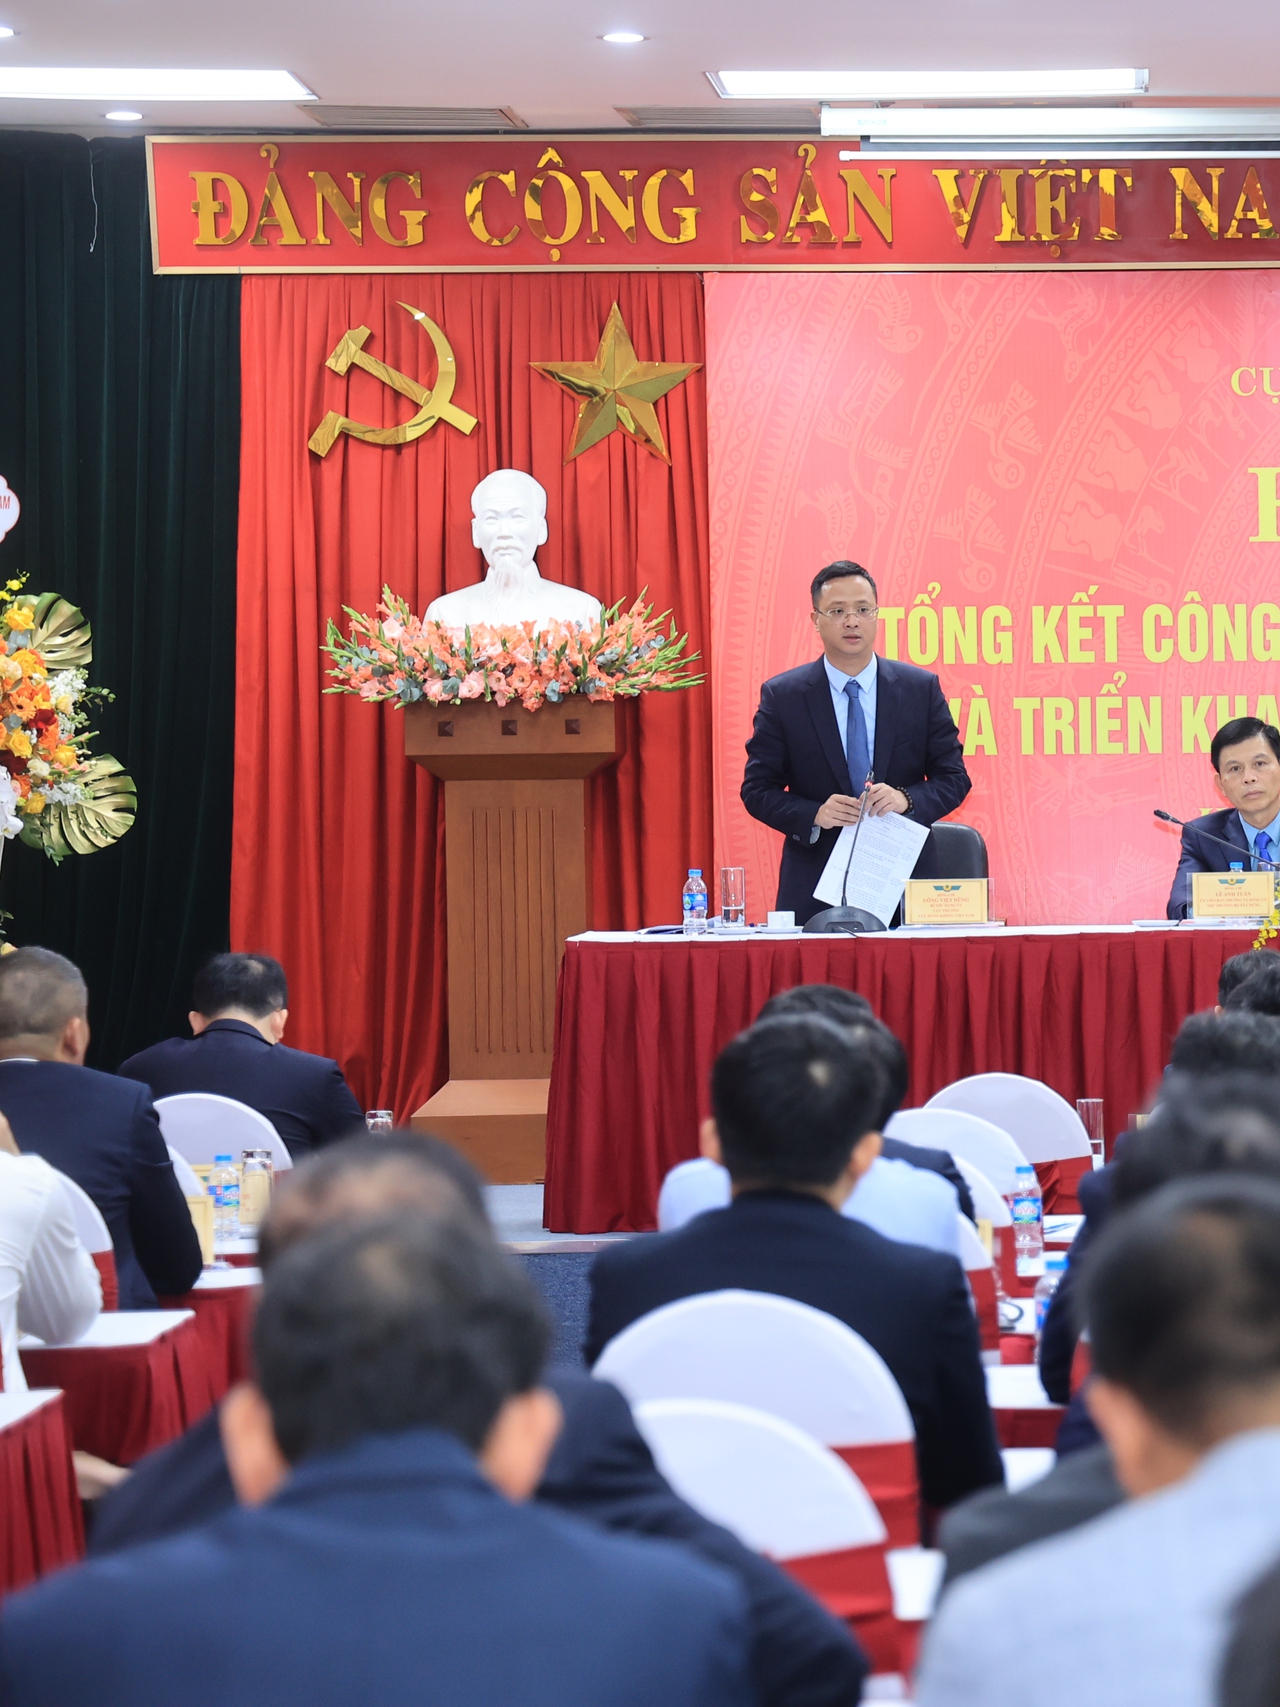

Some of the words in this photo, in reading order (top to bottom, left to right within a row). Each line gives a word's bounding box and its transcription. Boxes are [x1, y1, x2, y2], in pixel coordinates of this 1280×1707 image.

[189, 143, 429, 247] ĐẢNG
[465, 147, 701, 261] CỘNG
[740, 143, 896, 243] SẢN
[932, 159, 1133, 258] VIỆT
[878, 581, 1014, 666] TỔNG
[1032, 585, 1125, 664] KẾT
[1013, 671, 1163, 755] TRIỂN
